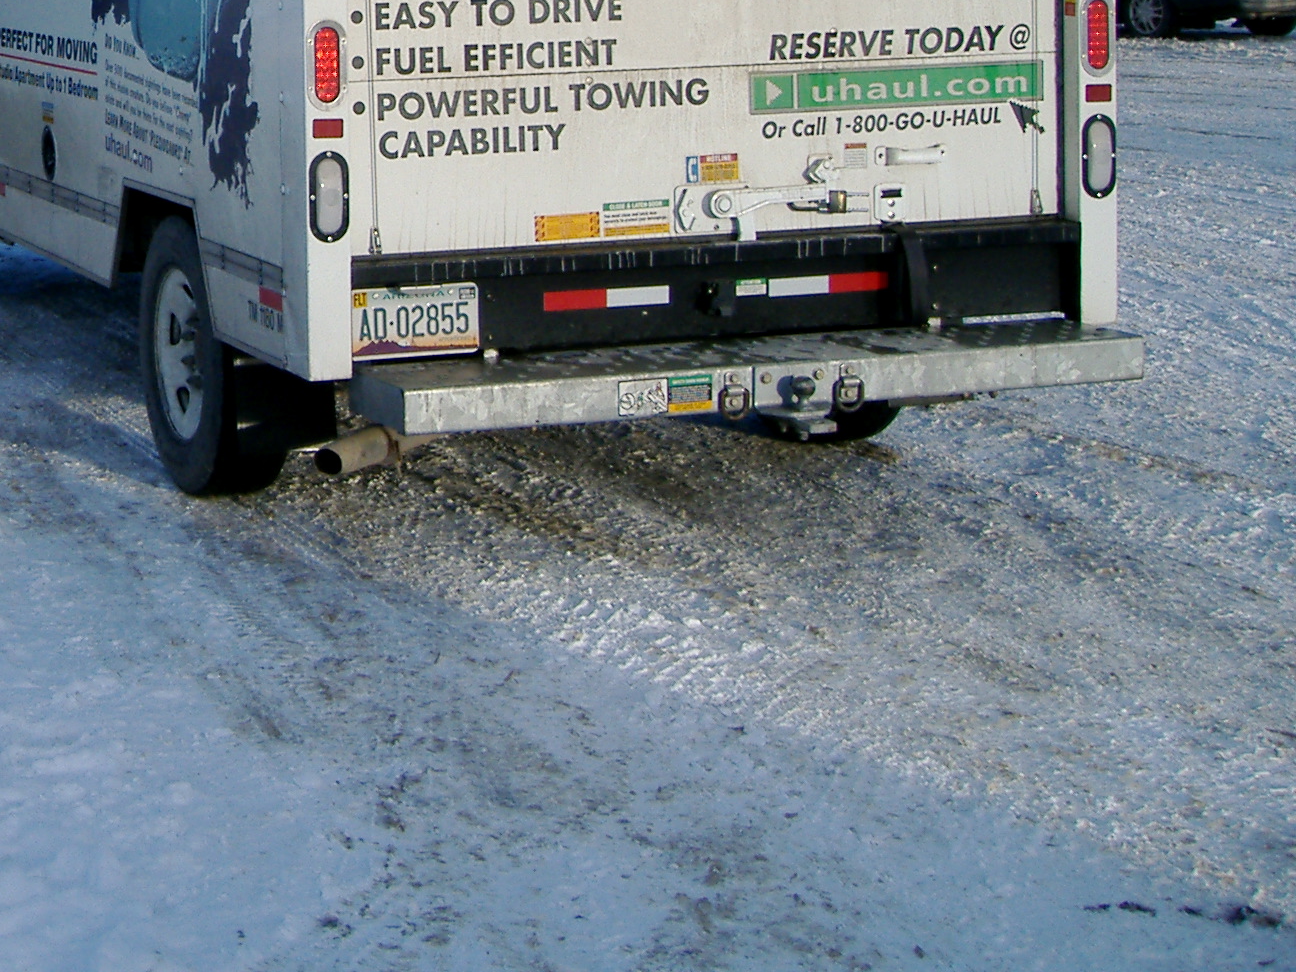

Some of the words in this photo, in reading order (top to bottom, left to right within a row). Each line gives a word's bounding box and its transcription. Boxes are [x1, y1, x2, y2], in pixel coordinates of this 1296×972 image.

[375, 1, 459, 30] EASY
[471, 0, 515, 26] TO
[35, 33, 54, 57] FOR
[57, 36, 98, 64] MOVING
[376, 47, 452, 75] FUEL
[464, 39, 617, 72] EFFICIENT
[769, 30, 894, 60] RESERVE
[905, 25, 1004, 54] TODAY
[1009, 23, 1030, 50] @
[14, 65, 45, 88] Apartment
[46, 72, 54, 94] Up
[56, 75, 62, 93] to
[68, 76, 99, 100] Bedroom
[377, 87, 558, 121] POWERFUL
[569, 78, 709, 111] TOWING
[812, 74, 1028, 103] uhaul.com
[762, 121, 786, 139] Or
[792, 117, 826, 136] Call
[835, 107, 1002, 134] 1-800-GO-U-HAUL
[105, 133, 153, 173] uhaul.com
[379, 123, 566, 159] CAPABILITY
[354, 293, 367, 307] FLT
